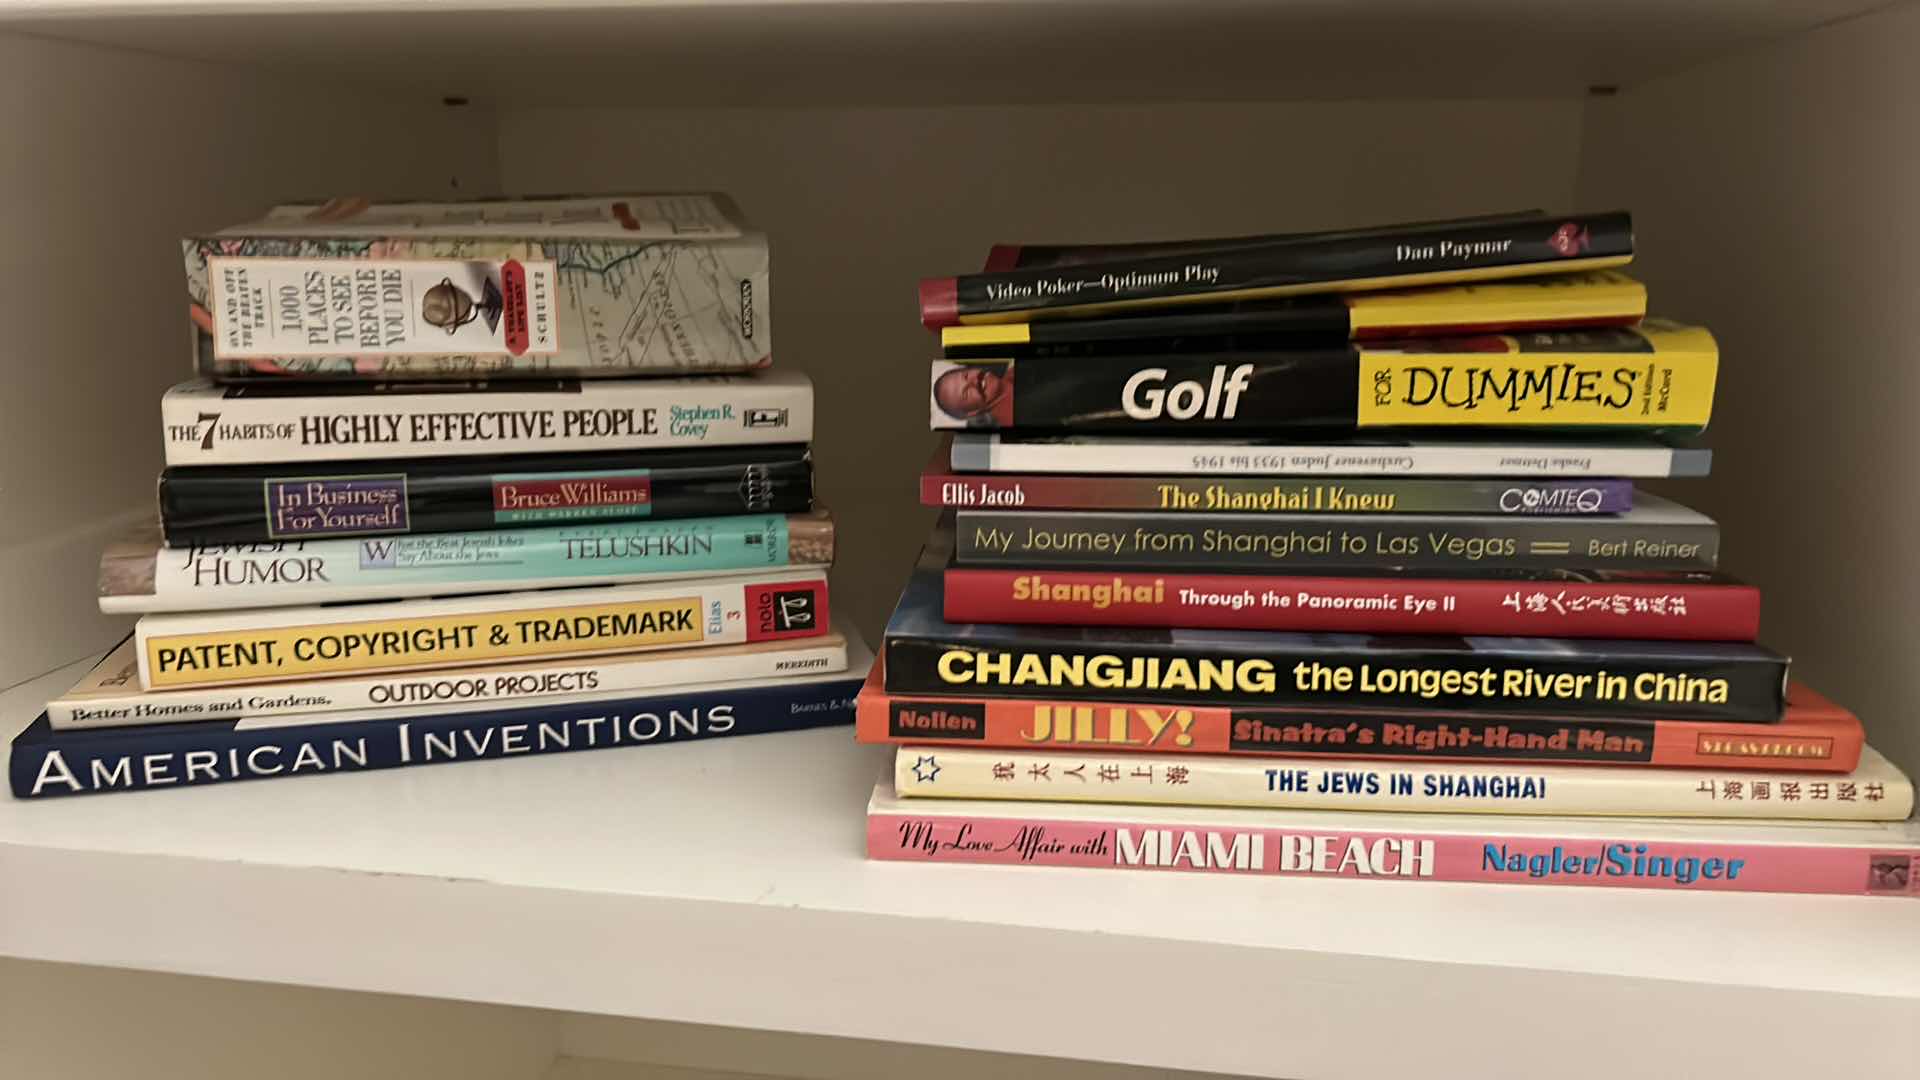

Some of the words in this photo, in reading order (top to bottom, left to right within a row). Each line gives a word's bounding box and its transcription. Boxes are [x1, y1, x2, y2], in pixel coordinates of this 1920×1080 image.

[1396, 244, 1434, 262] Dan
[1440, 238, 1512, 261] Paymar
[331, 275, 352, 312] SEE
[382, 269, 402, 303] DIE
[986, 281, 1032, 300] Video
[1185, 264, 1221, 284] Play
[252, 287, 265, 328] TRACK
[304, 271, 329, 345] PLACES
[356, 268, 380, 348] BEFORE
[534, 271, 548, 344] SCHULTZ
[334, 317, 354, 344] TO
[384, 311, 405, 346] YOU
[1121, 363, 1256, 421] Golf
[1375, 367, 1392, 407] FOR
[1402, 364, 1637, 412] DUMMIES
[168, 425, 200, 443] THE
[198, 411, 222, 450] 7
[220, 423, 275, 442] HABITS
[276, 422, 297, 439] OF
[300, 413, 402, 446] HIGHLY
[410, 411, 557, 443] EFFECTIVE
[563, 408, 659, 439] PEOPLE
[670, 404, 720, 427] Stephen
[722, 403, 735, 420] R.
[670, 419, 709, 440] Covey
[278, 484, 301, 508] In
[308, 482, 399, 506] Business
[501, 485, 561, 508] Bruce
[560, 482, 647, 505] Williams
[942, 482, 975, 505] Ellis
[979, 483, 1025, 506] Jacob
[1157, 484, 1201, 509] The
[1205, 485, 1310, 511] Shanghai
[1313, 487, 1324, 511] I
[1327, 485, 1398, 511] Knew
[278, 508, 316, 531] For
[318, 503, 400, 529] Yourself
[560, 534, 713, 559] TELUSHKIN
[974, 528, 1014, 553] My
[1021, 528, 1127, 555] Journey
[1134, 528, 1195, 551] from
[1202, 530, 1331, 558] Shanghai
[1340, 534, 1368, 555] to
[1376, 533, 1420, 555] Las
[1428, 534, 1516, 561] Vegas
[1588, 538, 1629, 558] Bert
[1633, 538, 1701, 559] Reiner
[194, 557, 330, 586] HUMOR
[1012, 576, 1166, 609] Shanghai
[1179, 588, 1255, 609] Through
[1261, 590, 1292, 609] the
[1297, 591, 1398, 611] Panoramic
[1404, 595, 1439, 614] Eye
[1444, 596, 1456, 612] II
[708, 600, 722, 635] Elias
[726, 609, 740, 622] 3
[757, 592, 773, 633] nolo
[159, 641, 284, 673] PATENT,
[294, 624, 480, 662] COPYRIGHT
[488, 623, 511, 646] &
[516, 608, 695, 644] TRADEMARK
[369, 676, 489, 704] OUTDOOR
[495, 671, 599, 696] PROJECTS
[937, 650, 1276, 694] CHANGJIANG
[1293, 661, 1353, 693] the
[1360, 664, 1498, 698] Longest
[1503, 668, 1592, 699] River
[1596, 670, 1629, 700] in
[1634, 672, 1729, 704] China
[71, 706, 131, 722] Better
[135, 701, 205, 718] Homes
[208, 698, 243, 713] and
[1020, 705, 1197, 747] JILLY!
[30, 738, 368, 795] AMERICAN
[398, 705, 736, 763] INVENTIONS
[1232, 718, 1375, 745] Sinatra's
[1382, 721, 1570, 751] Right-Hand
[1577, 728, 1646, 753] Man
[1265, 769, 1309, 793] THE
[1318, 771, 1380, 795] JEWS
[1390, 773, 1414, 796] IN
[1423, 774, 1547, 798] SHANGHAI
[1697, 780, 1884, 802] 上海画报出版社
[899, 820, 939, 856] My
[942, 823, 993, 851] Love
[994, 825, 1065, 861] Affair
[1070, 830, 1109, 856] with
[1114, 829, 1265, 872] MIAMI
[1280, 834, 1436, 877] BEACH
[1482, 842, 1745, 884] Nagler/Singer
